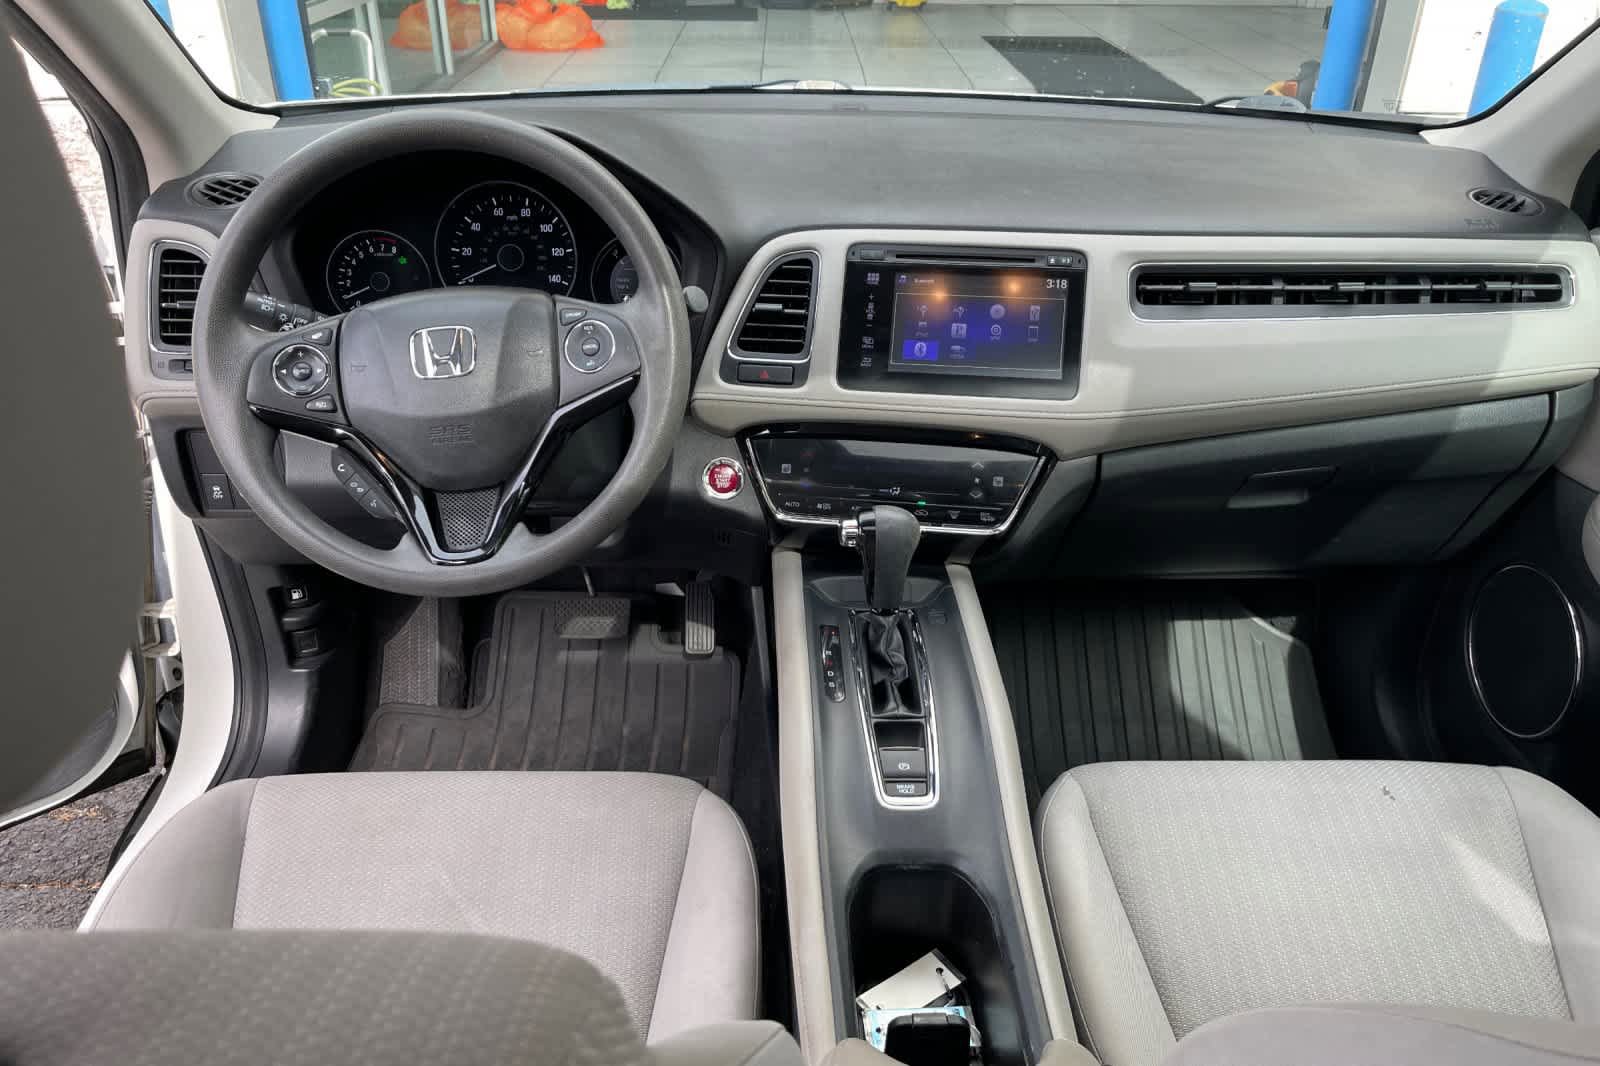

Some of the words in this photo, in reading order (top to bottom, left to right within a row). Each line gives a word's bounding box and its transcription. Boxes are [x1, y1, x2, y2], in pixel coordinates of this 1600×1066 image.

[493, 207, 504, 216] 60
[520, 208, 531, 217] 80
[470, 222, 481, 231] 40
[539, 224, 553, 233] 100
[461, 247, 472, 256] 20
[551, 247, 565, 256] 120
[548, 274, 561, 283] 140
[1046, 279, 1068, 289] 3:18
